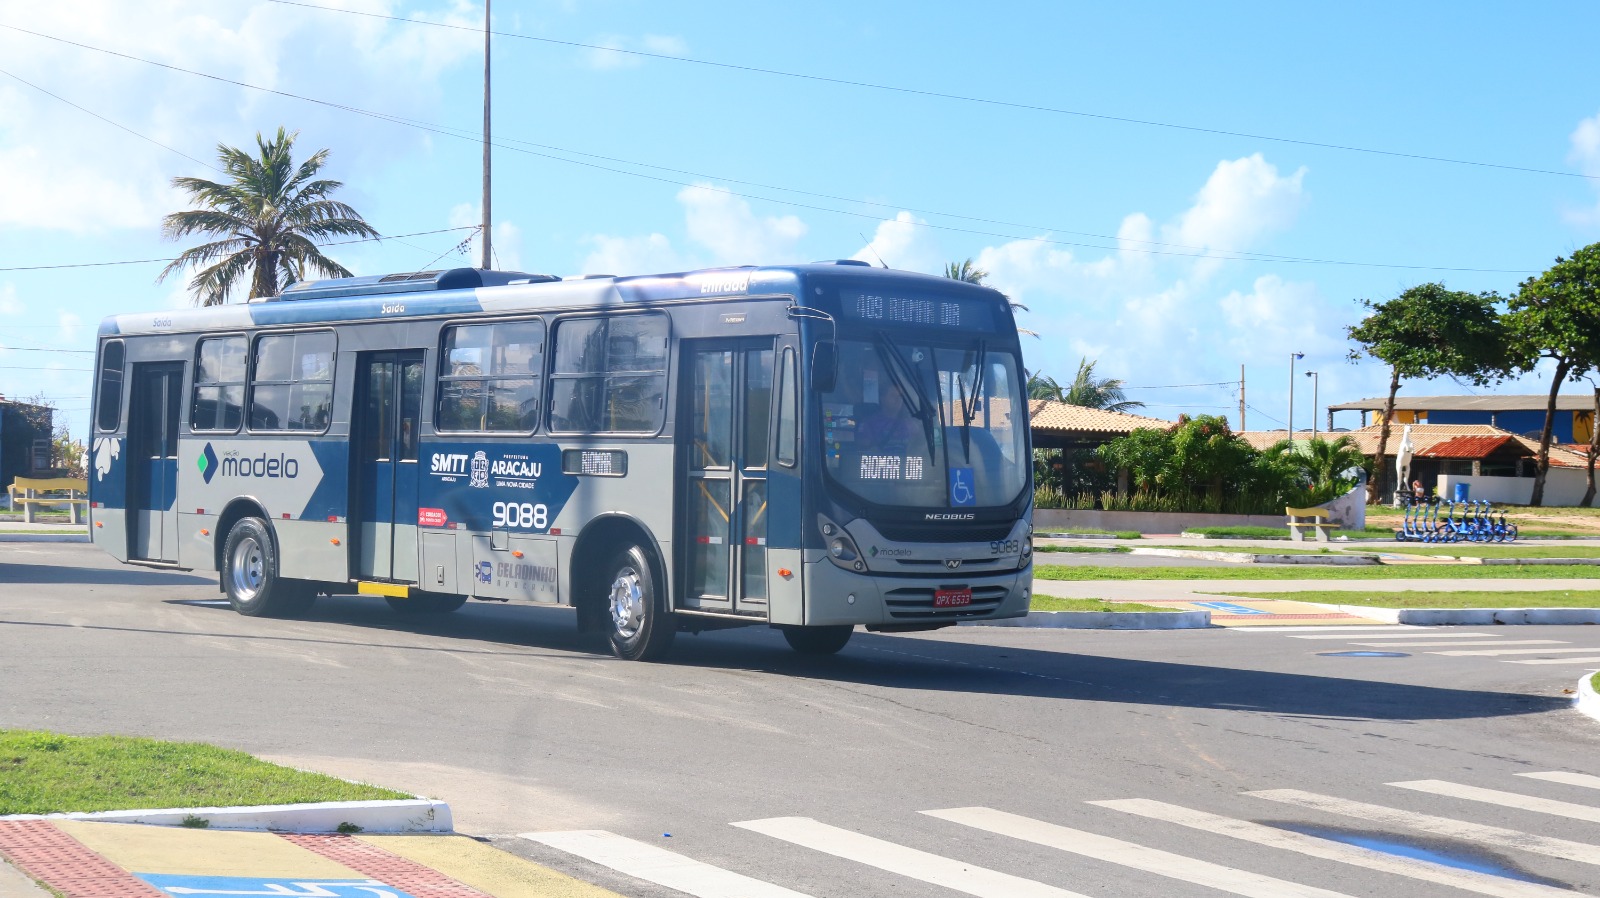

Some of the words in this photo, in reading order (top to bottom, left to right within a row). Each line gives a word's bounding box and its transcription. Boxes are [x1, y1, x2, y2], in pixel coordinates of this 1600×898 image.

[889, 297, 935, 324] RIOMAR
[940, 302, 960, 326] DIA
[222, 452, 299, 478] modelo
[431, 452, 468, 473] SMTT
[491, 460, 542, 478] ARACAJU
[582, 451, 612, 474] RIOMAR
[860, 455, 901, 479] RIOMAR
[905, 456, 923, 480] DIA
[492, 501, 548, 529] 9088
[880, 548, 912, 557] modelo
